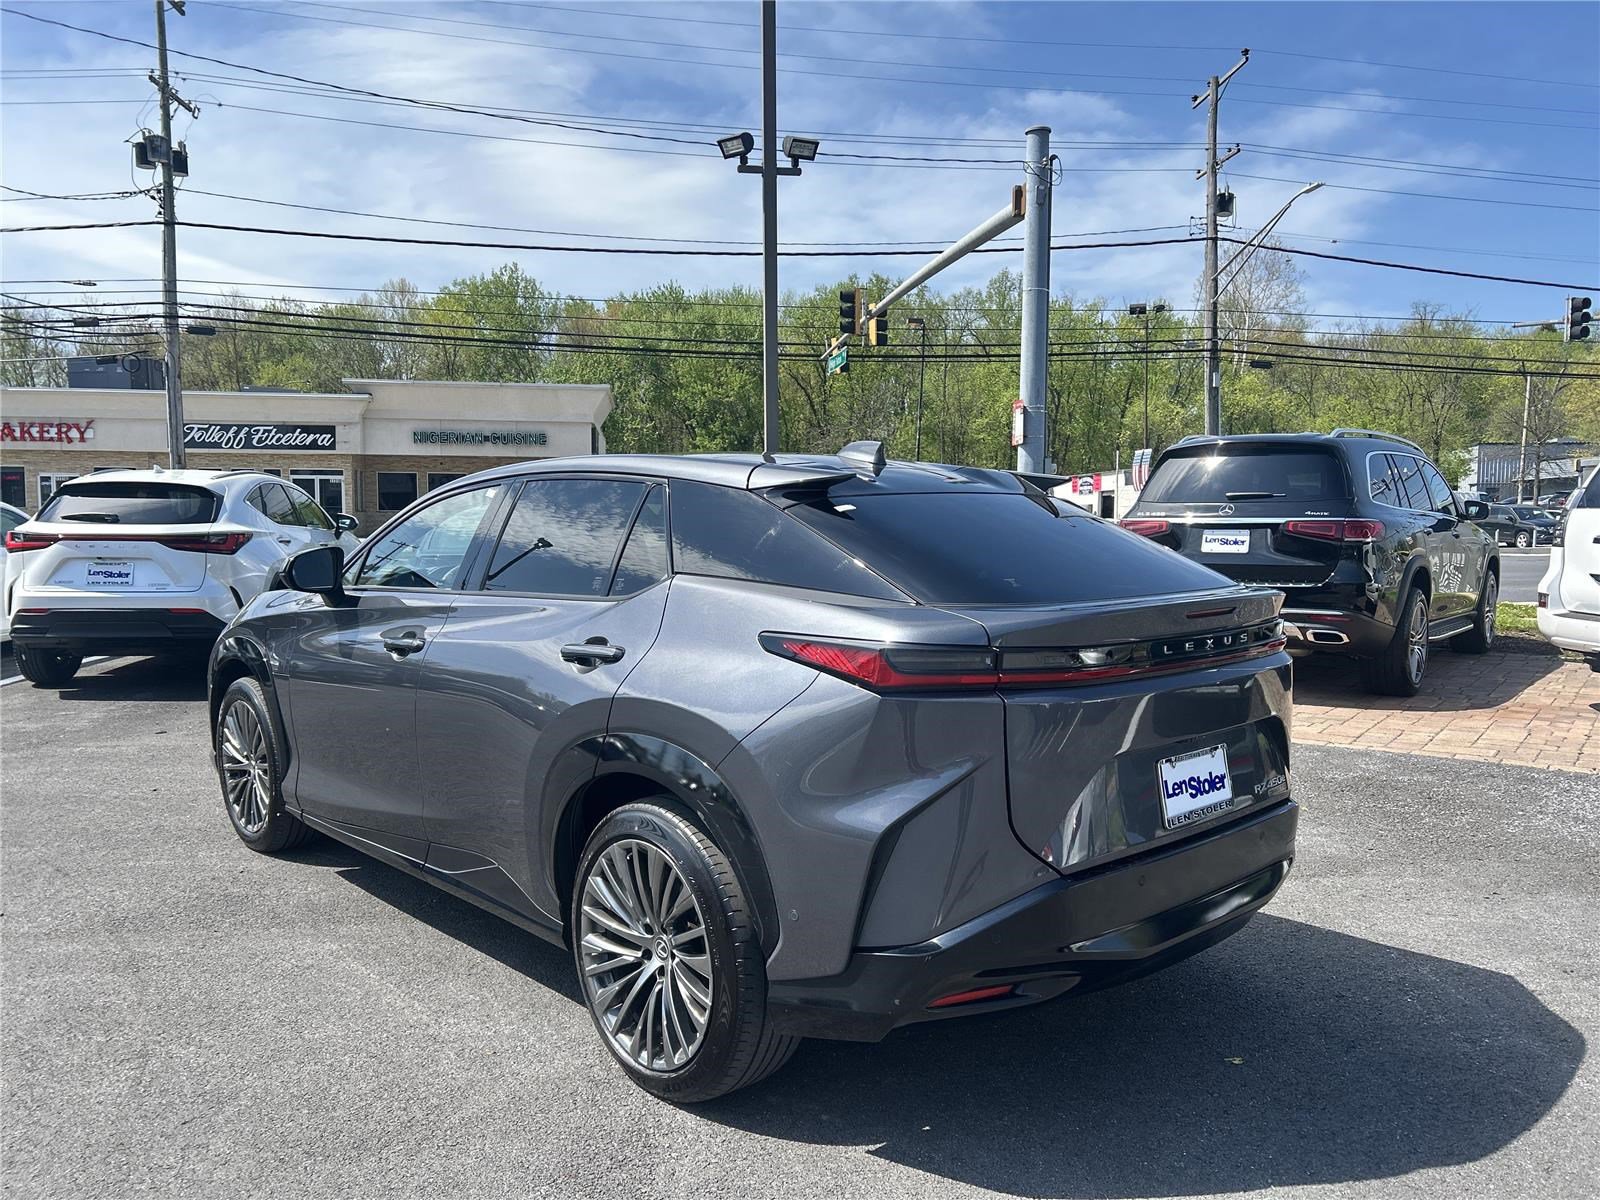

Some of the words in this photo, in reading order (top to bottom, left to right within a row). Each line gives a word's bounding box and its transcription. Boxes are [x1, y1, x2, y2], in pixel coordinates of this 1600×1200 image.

[184, 424, 249, 449] Tolloff
[251, 425, 334, 447] Etcetera
[413, 431, 484, 444] NIGERIAN
[490, 432, 547, 446] CUISINE
[1163, 633, 1248, 654] LEXUS
[1171, 814, 1191, 826] LEN
[1194, 800, 1232, 819] STOLER
